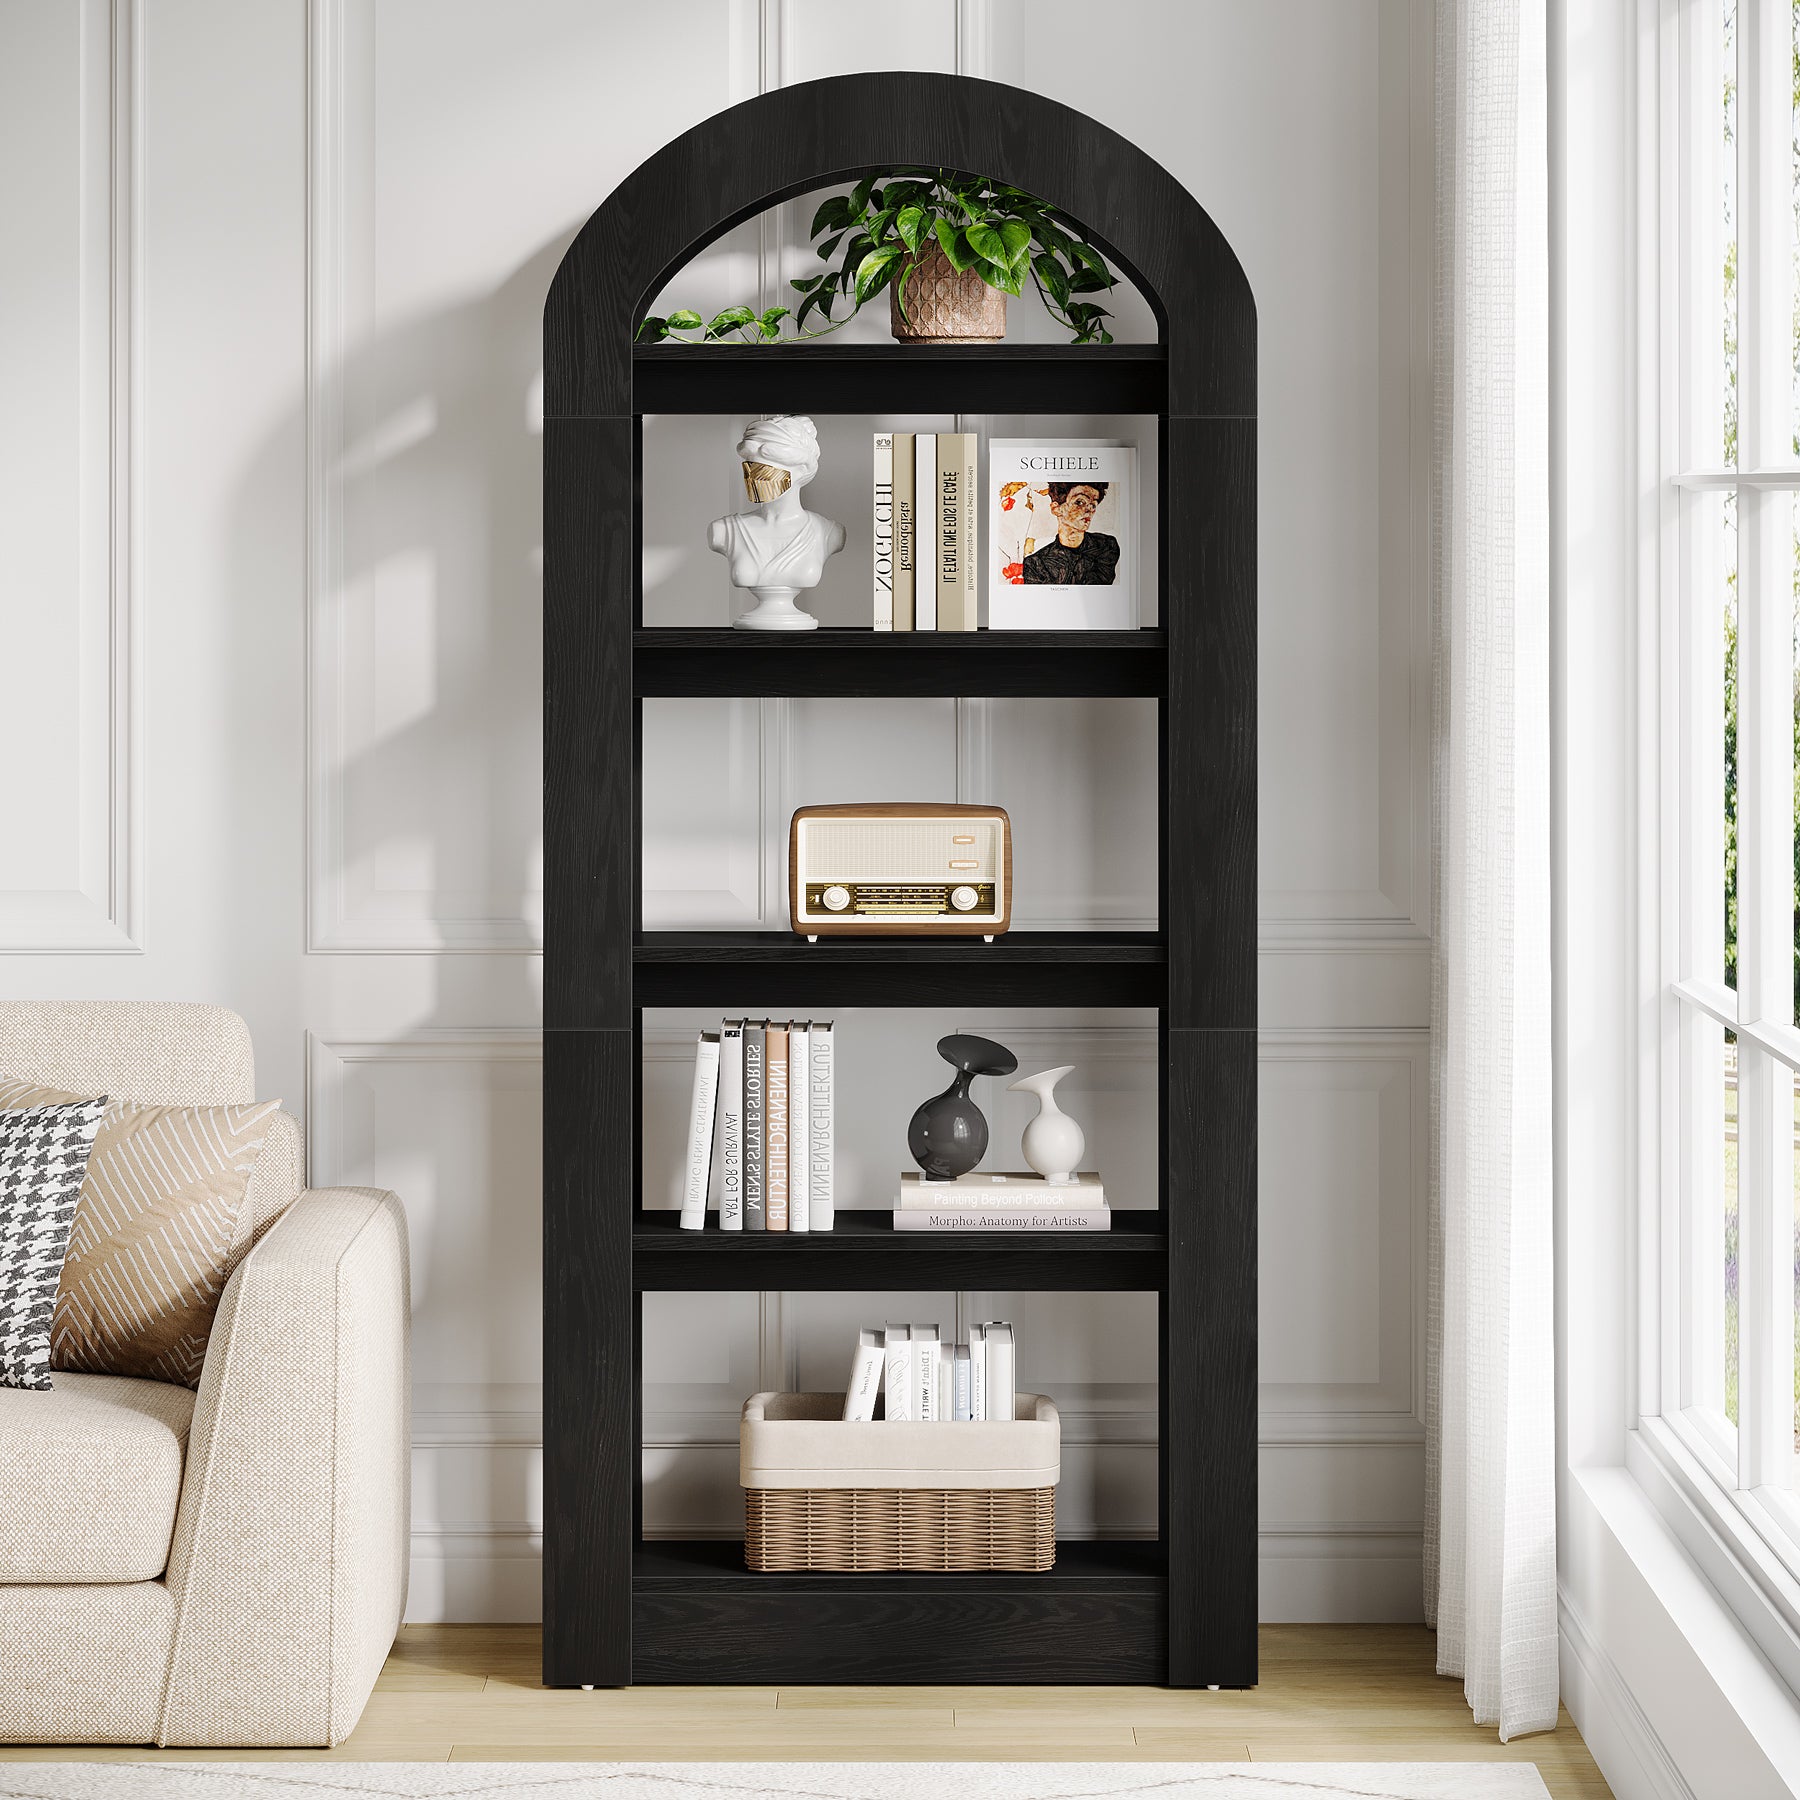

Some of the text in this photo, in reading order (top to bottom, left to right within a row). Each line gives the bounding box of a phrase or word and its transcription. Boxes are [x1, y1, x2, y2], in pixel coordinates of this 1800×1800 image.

[1020, 456, 1099, 470] SCHIELE
[934, 1193, 1065, 1208] Painting Beyond Pollock
[929, 1215, 1088, 1229] Morpho: Anatomy for Artists
